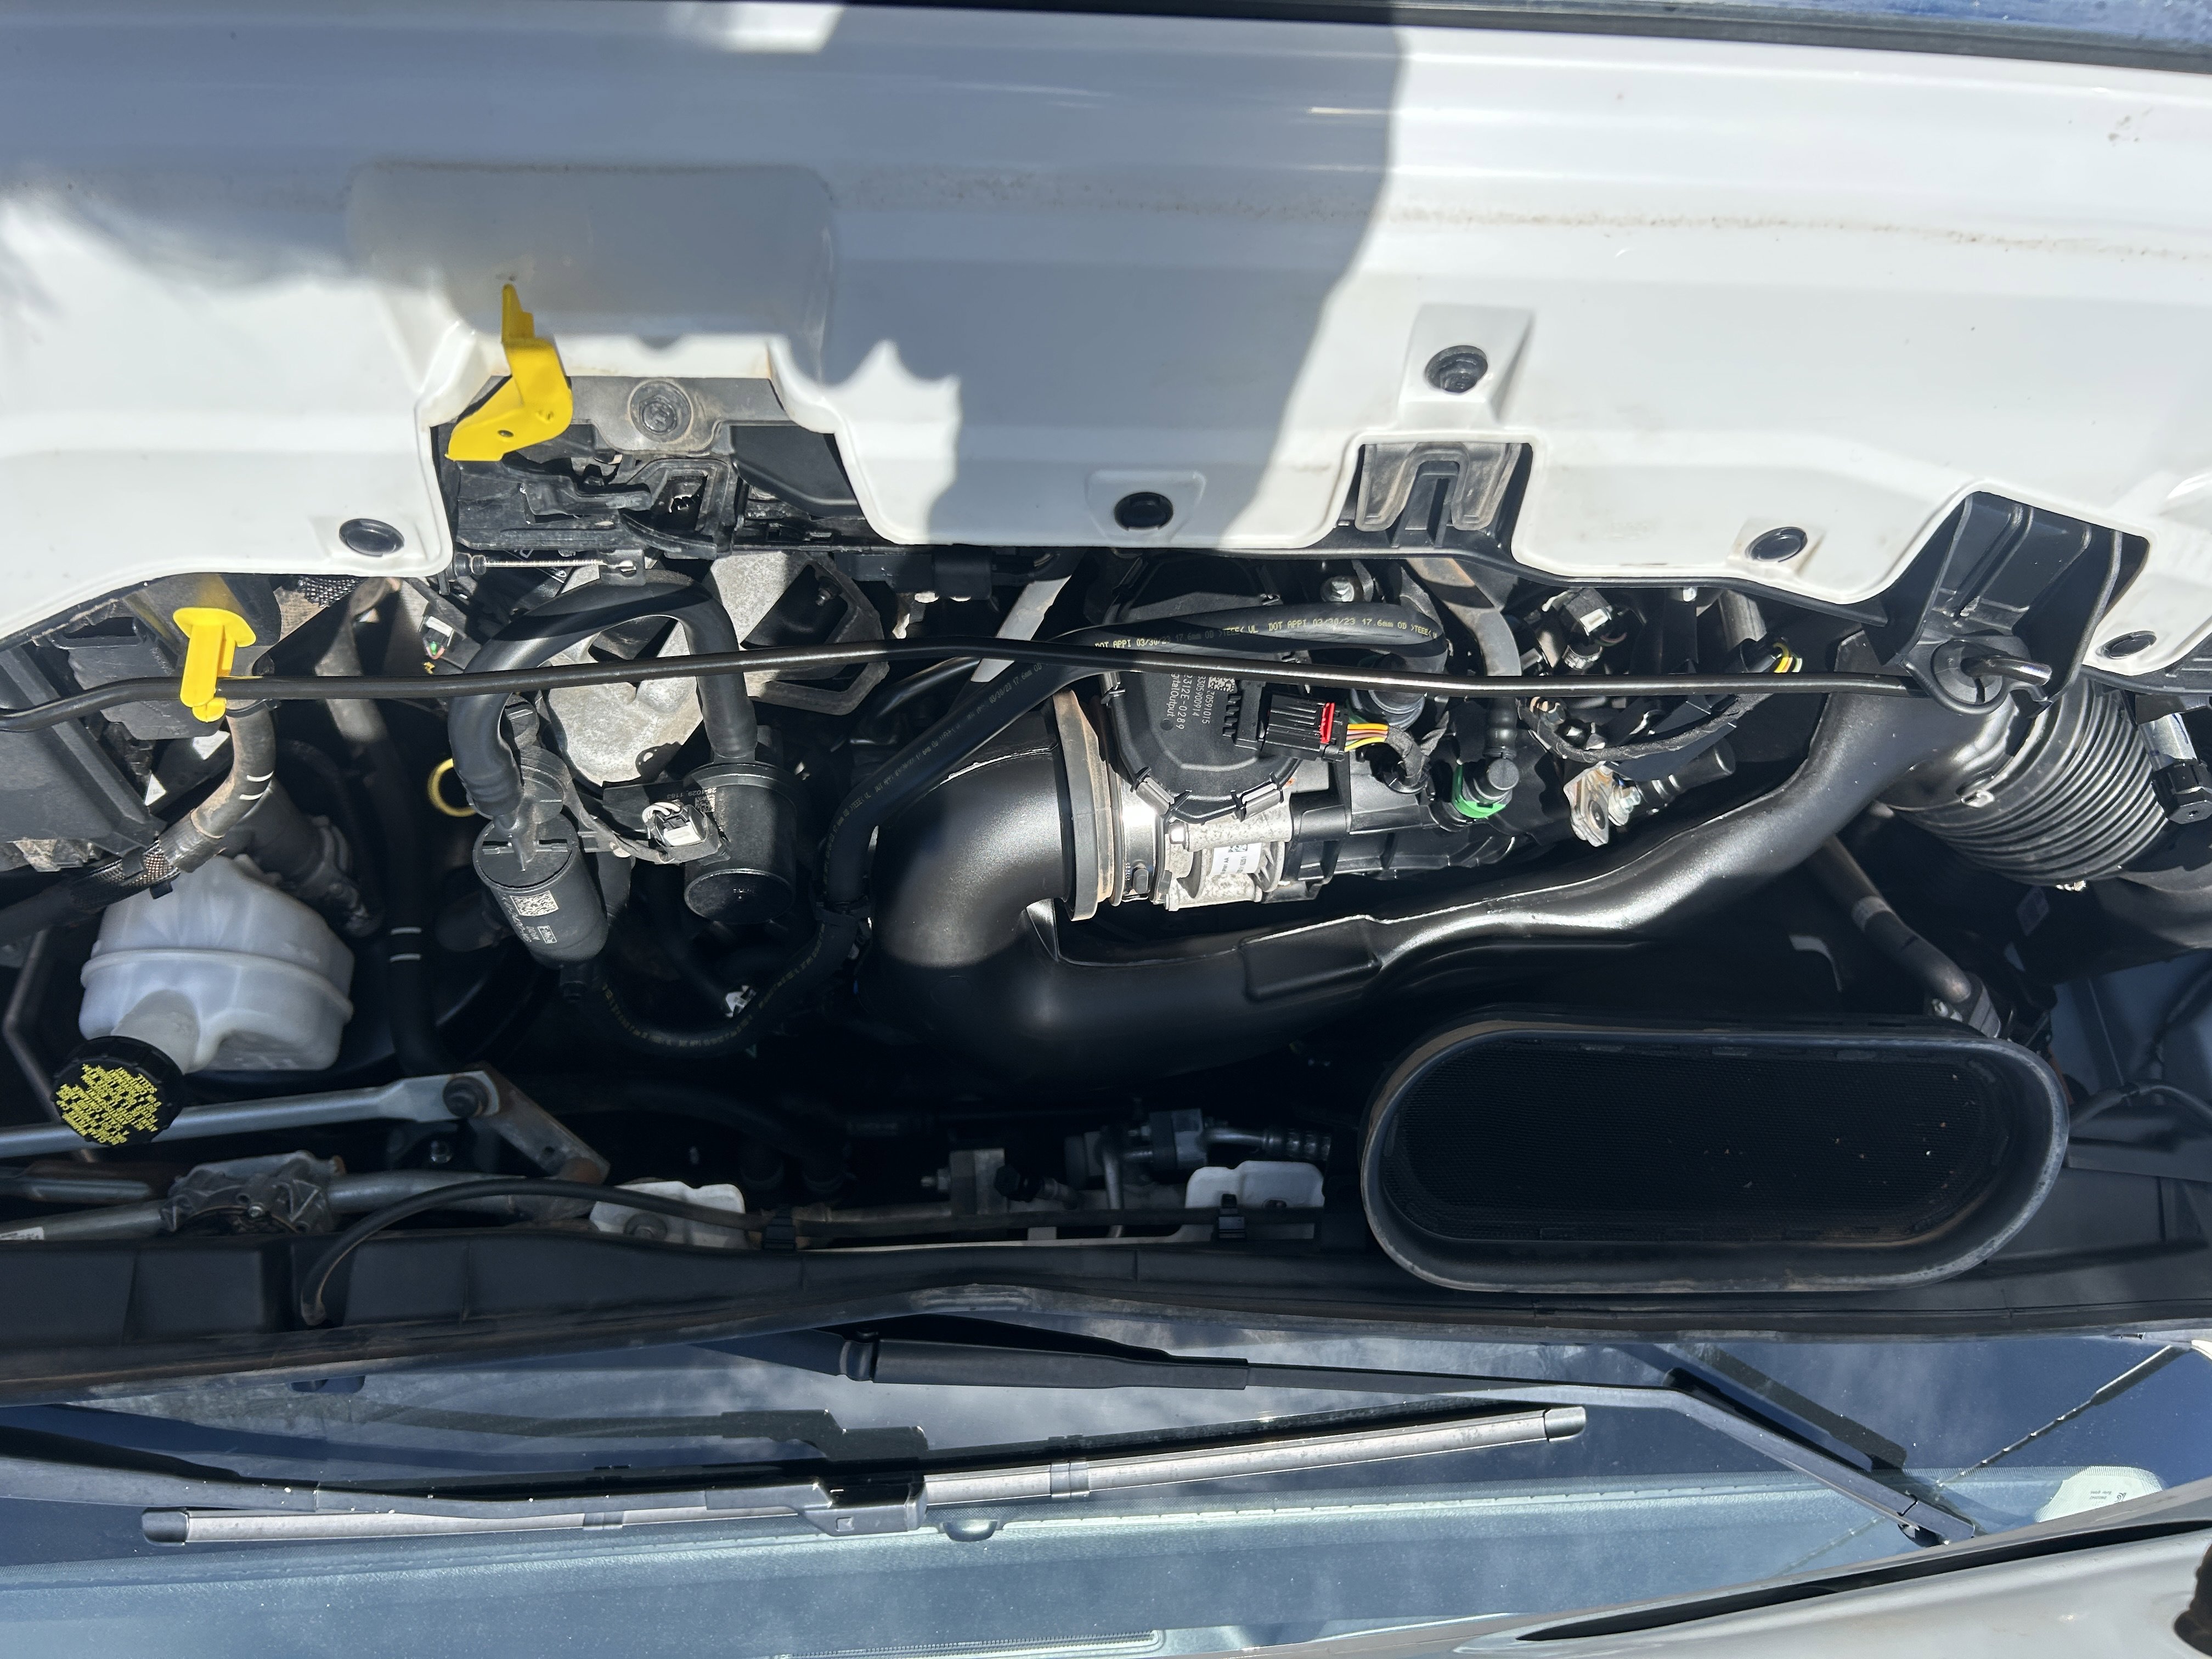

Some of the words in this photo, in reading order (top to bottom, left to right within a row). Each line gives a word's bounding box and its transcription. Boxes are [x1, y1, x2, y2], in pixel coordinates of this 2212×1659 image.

[1268, 622, 1283, 631] DOT
[80, 1073, 109, 1097] BOUCHON
[106, 1068, 140, 1097] PROVENANT
[114, 1065, 148, 1094] CONTENANT
[55, 1089, 70, 1101] USE
[59, 1083, 79, 1099] FROM
[113, 1084, 126, 1094] DU
[55, 1099, 70, 1110] CAP
[76, 1099, 95, 1114] FLUID
[106, 1097, 118, 1106] LE
[120, 1101, 131, 1109] LE
[122, 1093, 137, 1105] QUE
[128, 1108, 140, 1116] DE
[135, 1104, 158, 1123] PLOYER
[143, 1102, 157, 1113] DOT
[67, 1110, 90, 1128] FILLER
[98, 1119, 112, 1130] DOT
[100, 1111, 123, 1130] SEALED
[115, 1106, 145, 1130] NETTOYER
[137, 1115, 159, 1132] AVANT
[86, 1126, 106, 1143] CLEAN
[95, 1126, 119, 1146] BEFORE
[110, 1130, 127, 1143] ONLY
